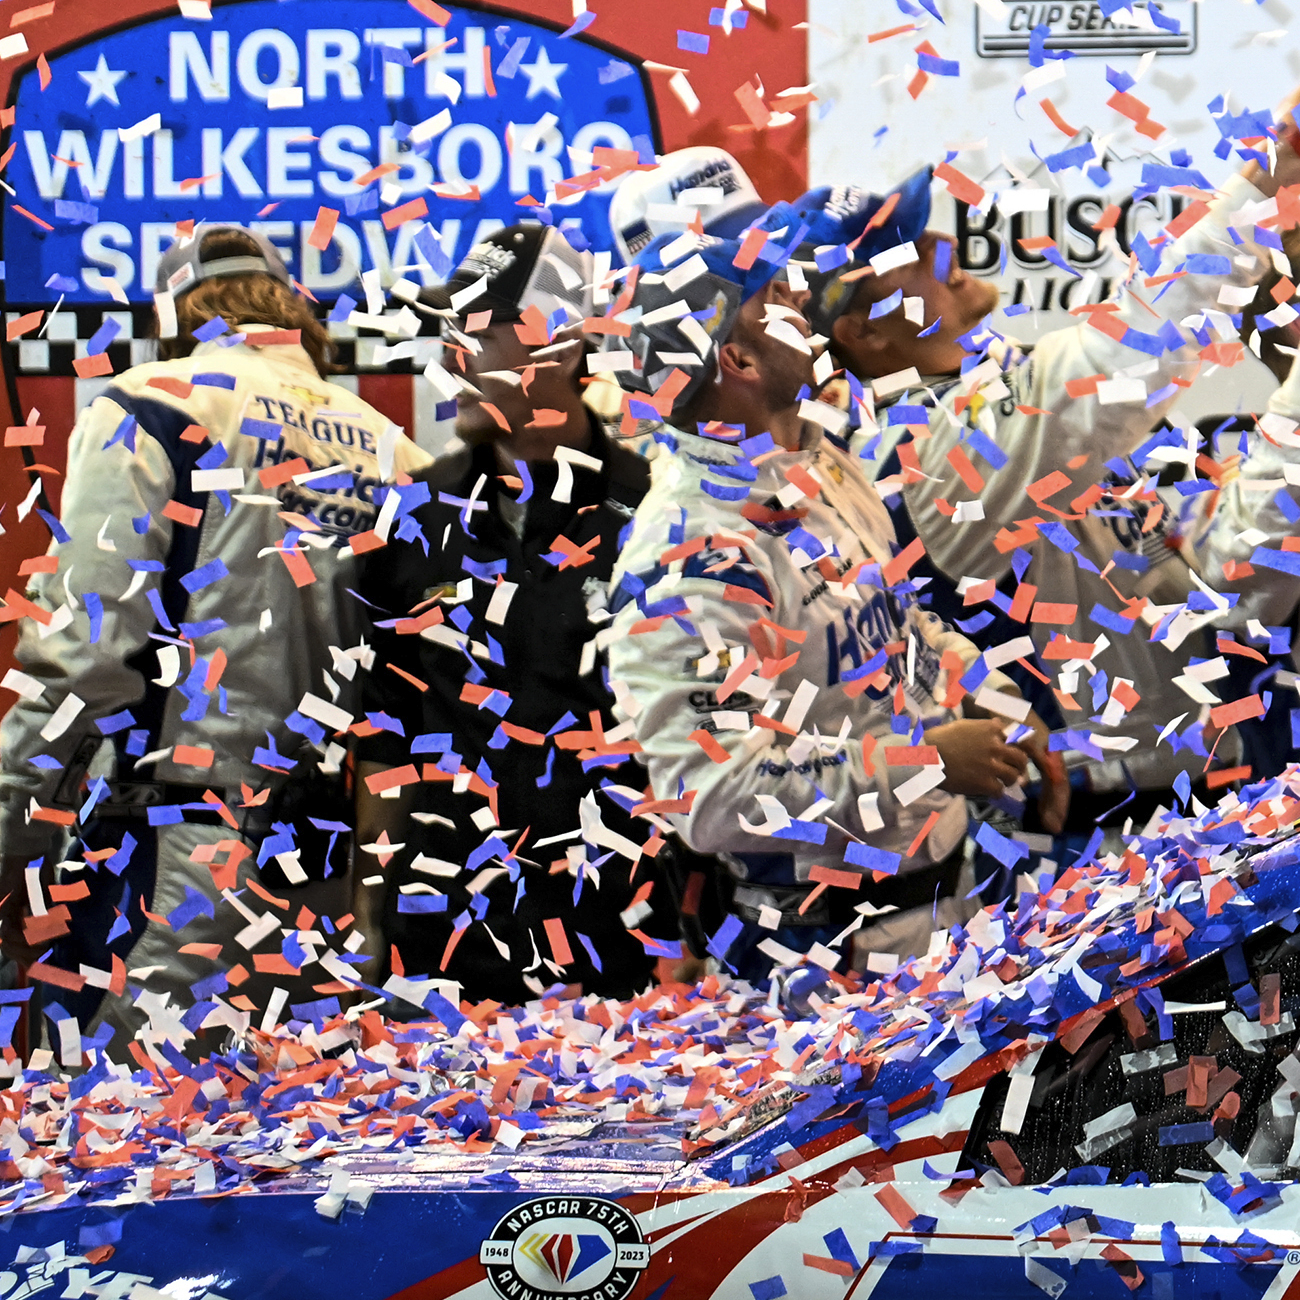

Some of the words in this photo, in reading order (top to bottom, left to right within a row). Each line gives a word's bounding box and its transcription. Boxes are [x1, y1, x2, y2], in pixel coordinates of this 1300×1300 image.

[1009, 4, 1063, 31] CUP
[168, 27, 488, 102] NORTH
[23, 122, 635, 201] WILKESBORO
[506, 1201, 580, 1233] NASCAR
[586, 1202, 630, 1235] 75TH
[485, 1247, 509, 1258] 1948
[620, 1250, 644, 1261] 2023
